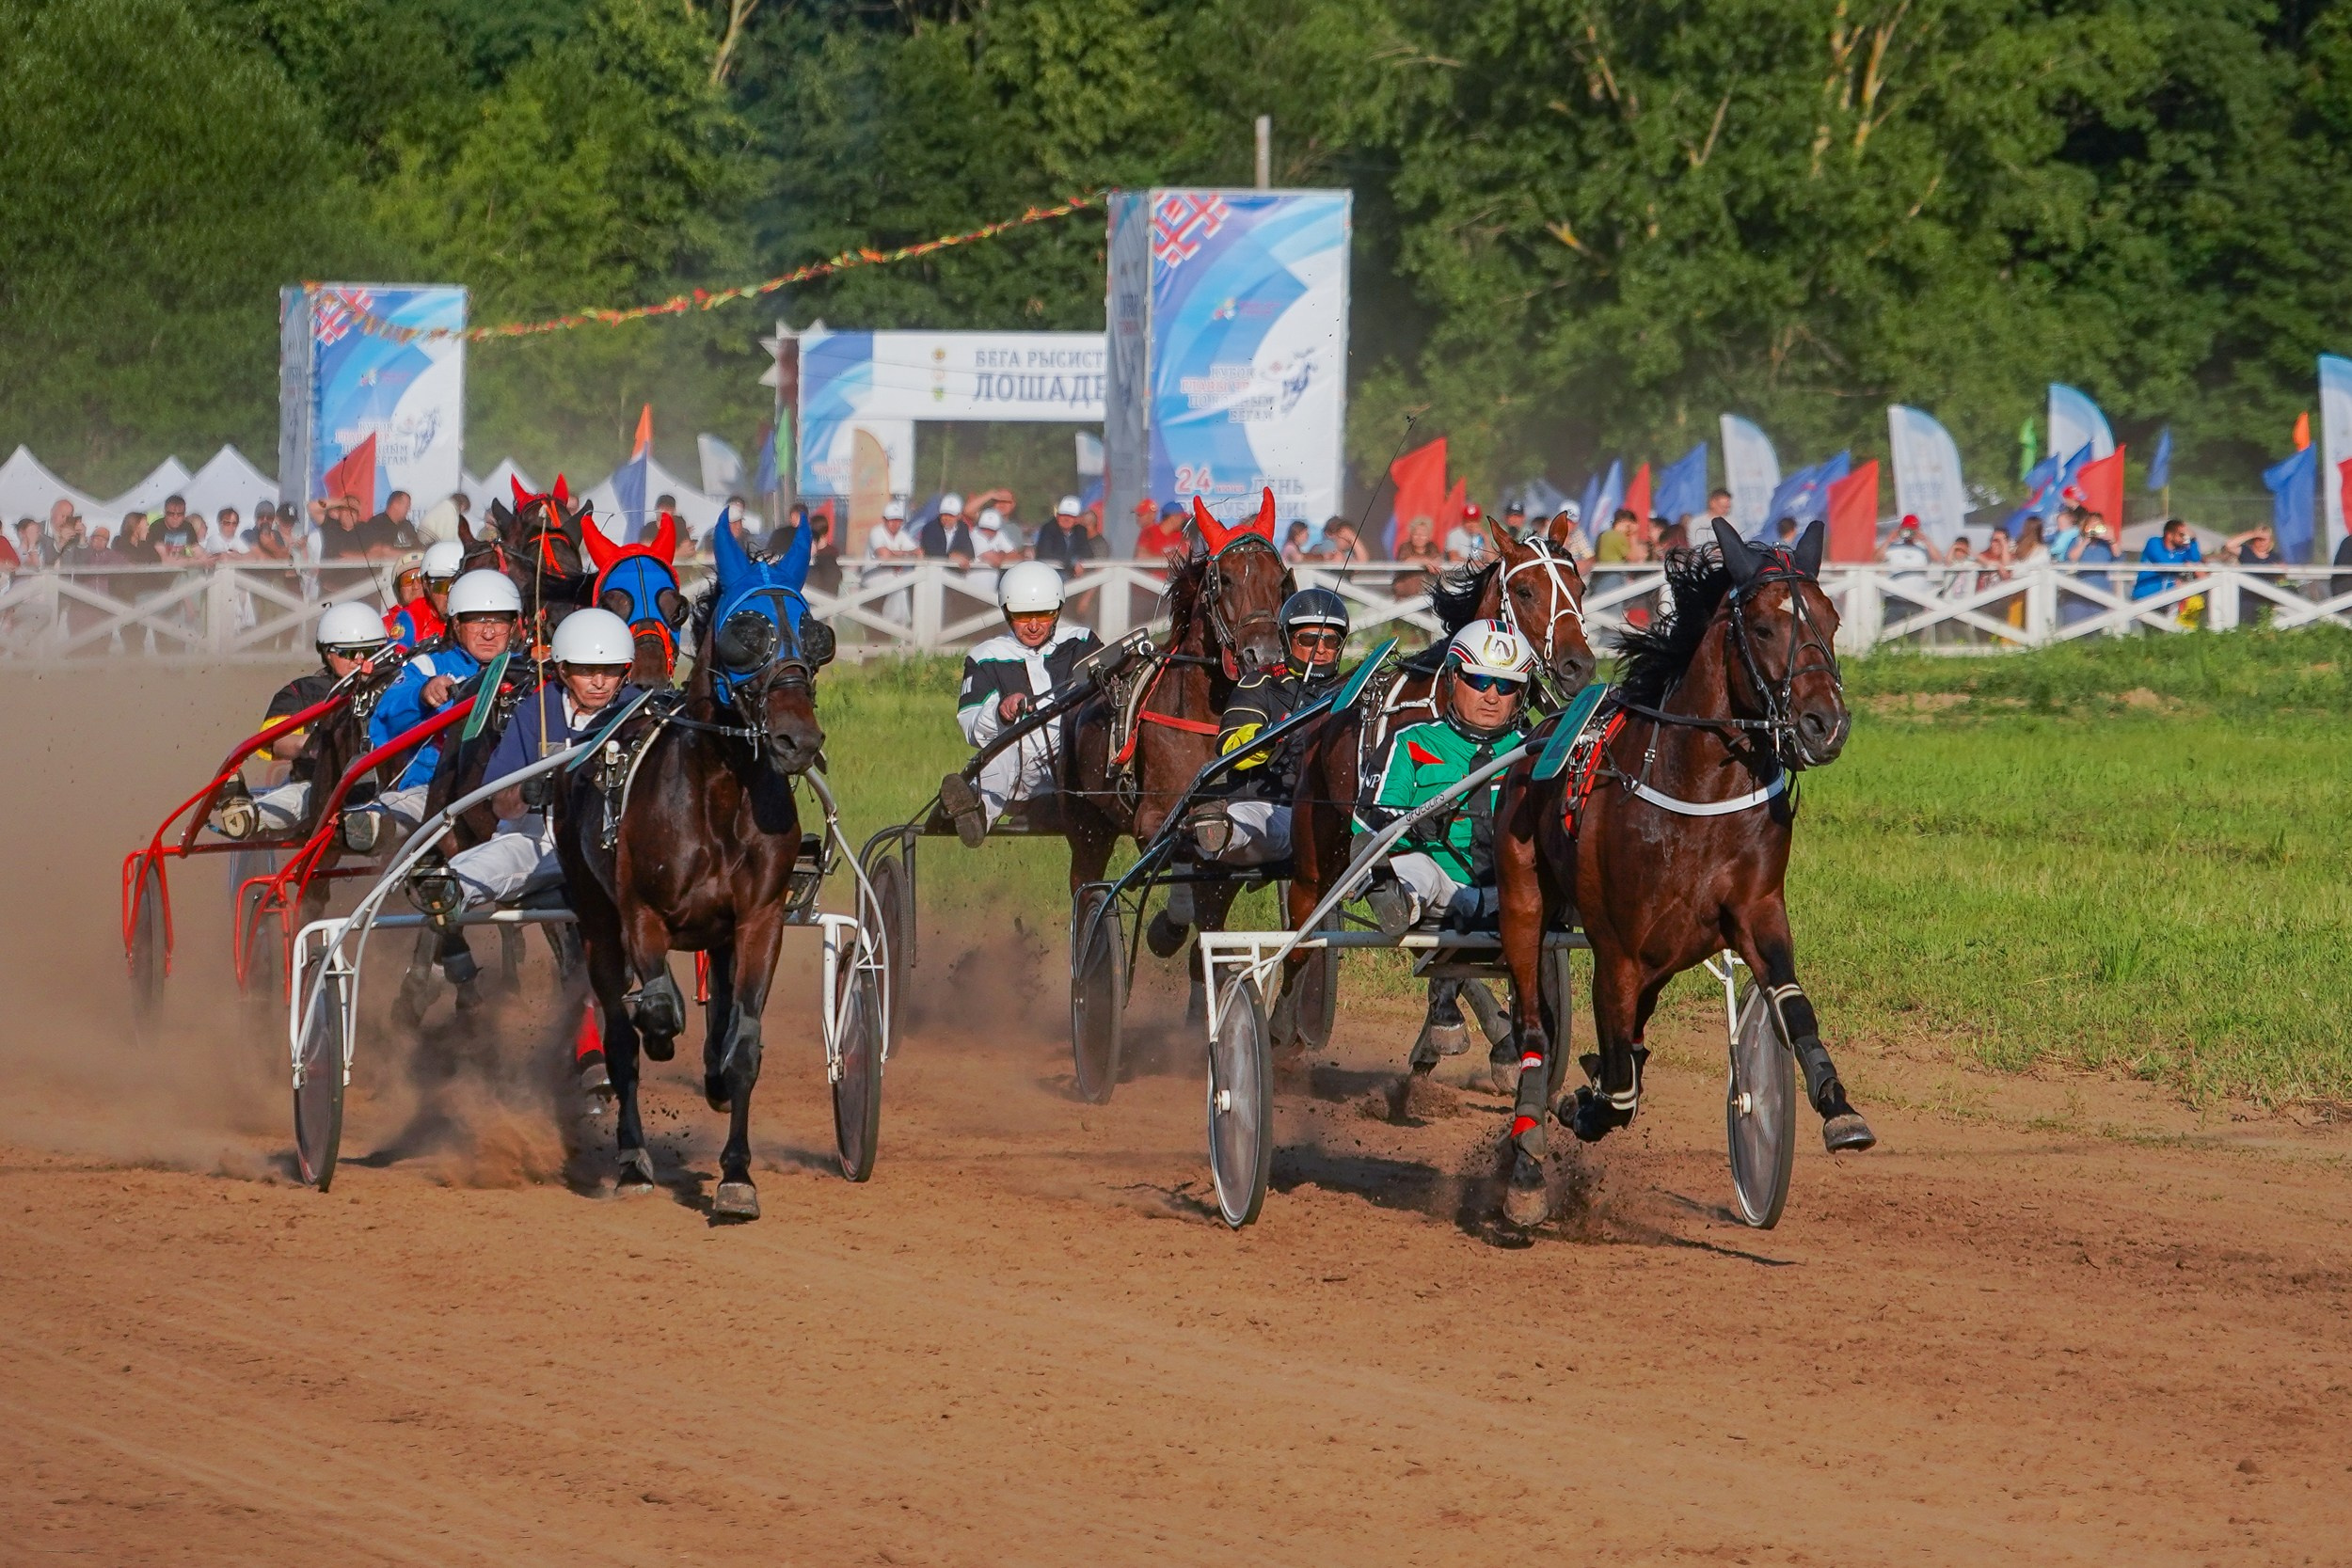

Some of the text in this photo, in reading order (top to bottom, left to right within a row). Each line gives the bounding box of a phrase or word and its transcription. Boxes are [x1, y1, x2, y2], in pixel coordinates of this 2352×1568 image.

[975, 351, 1021, 368] БЕГА
[1211, 367, 1255, 378] КУБОК
[973, 373, 1105, 408] ЛОШАДЕ
[1178, 468, 1211, 493] 24
[1546, 689, 1597, 760] 2
